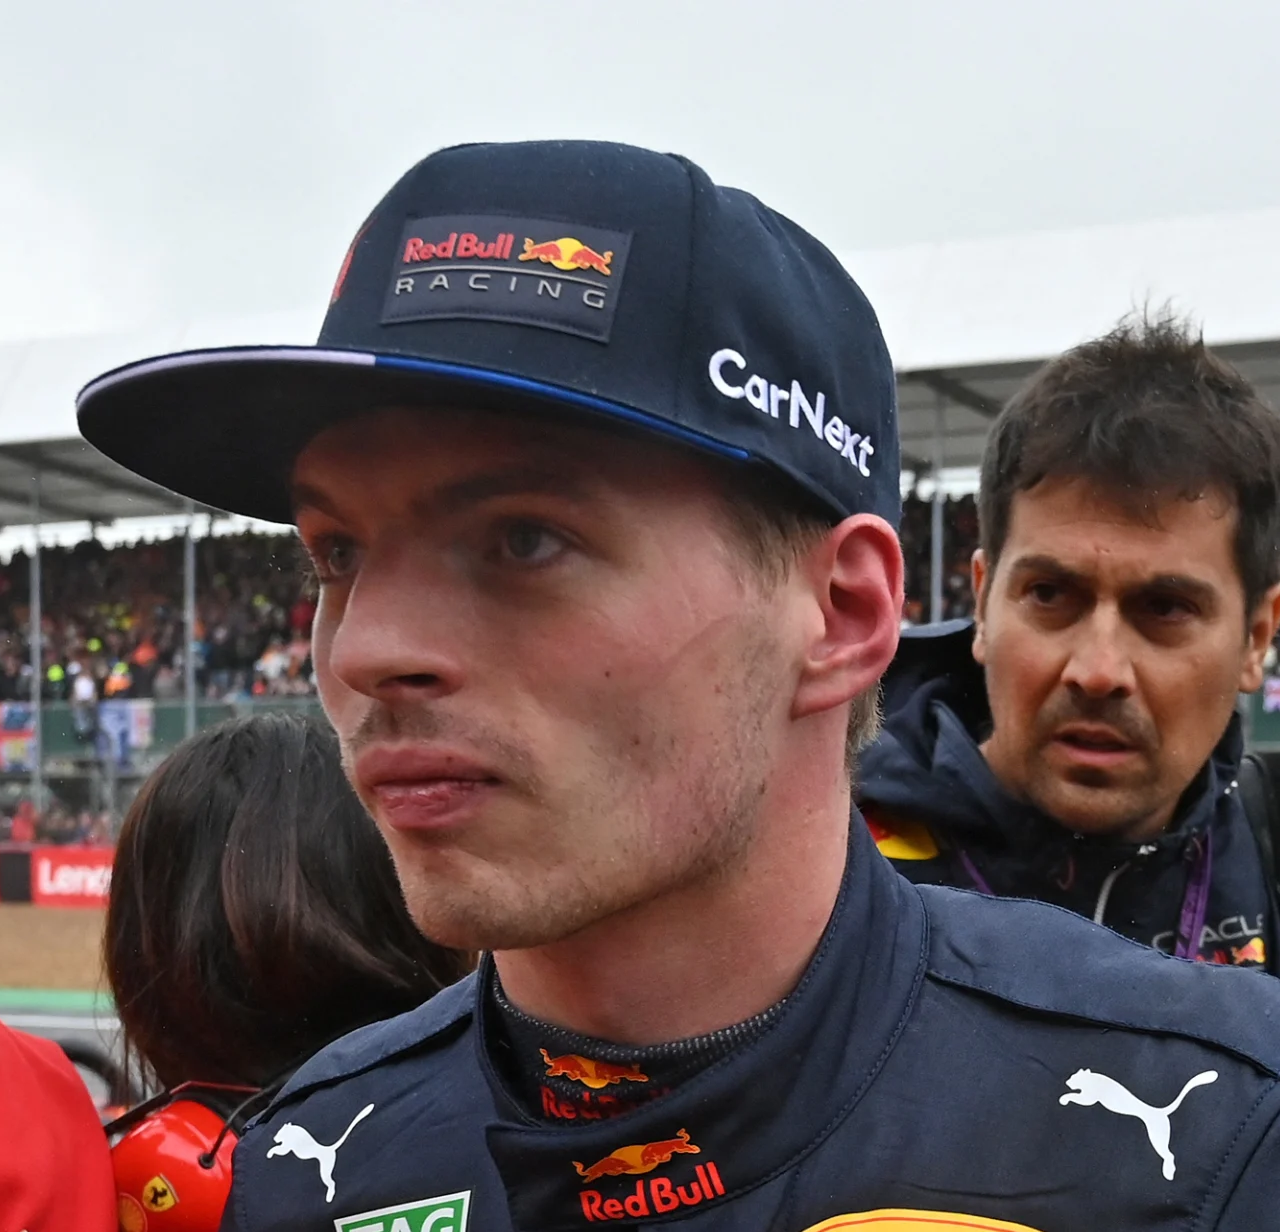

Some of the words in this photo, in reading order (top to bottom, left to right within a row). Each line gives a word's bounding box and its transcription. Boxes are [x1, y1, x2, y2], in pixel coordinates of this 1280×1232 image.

[403, 232, 458, 263] Red
[457, 232, 515, 260] Bull
[395, 272, 606, 309] RACING
[708, 348, 875, 477] CarNext
[579, 1179, 650, 1222] Red
[650, 1161, 726, 1214] Bull
